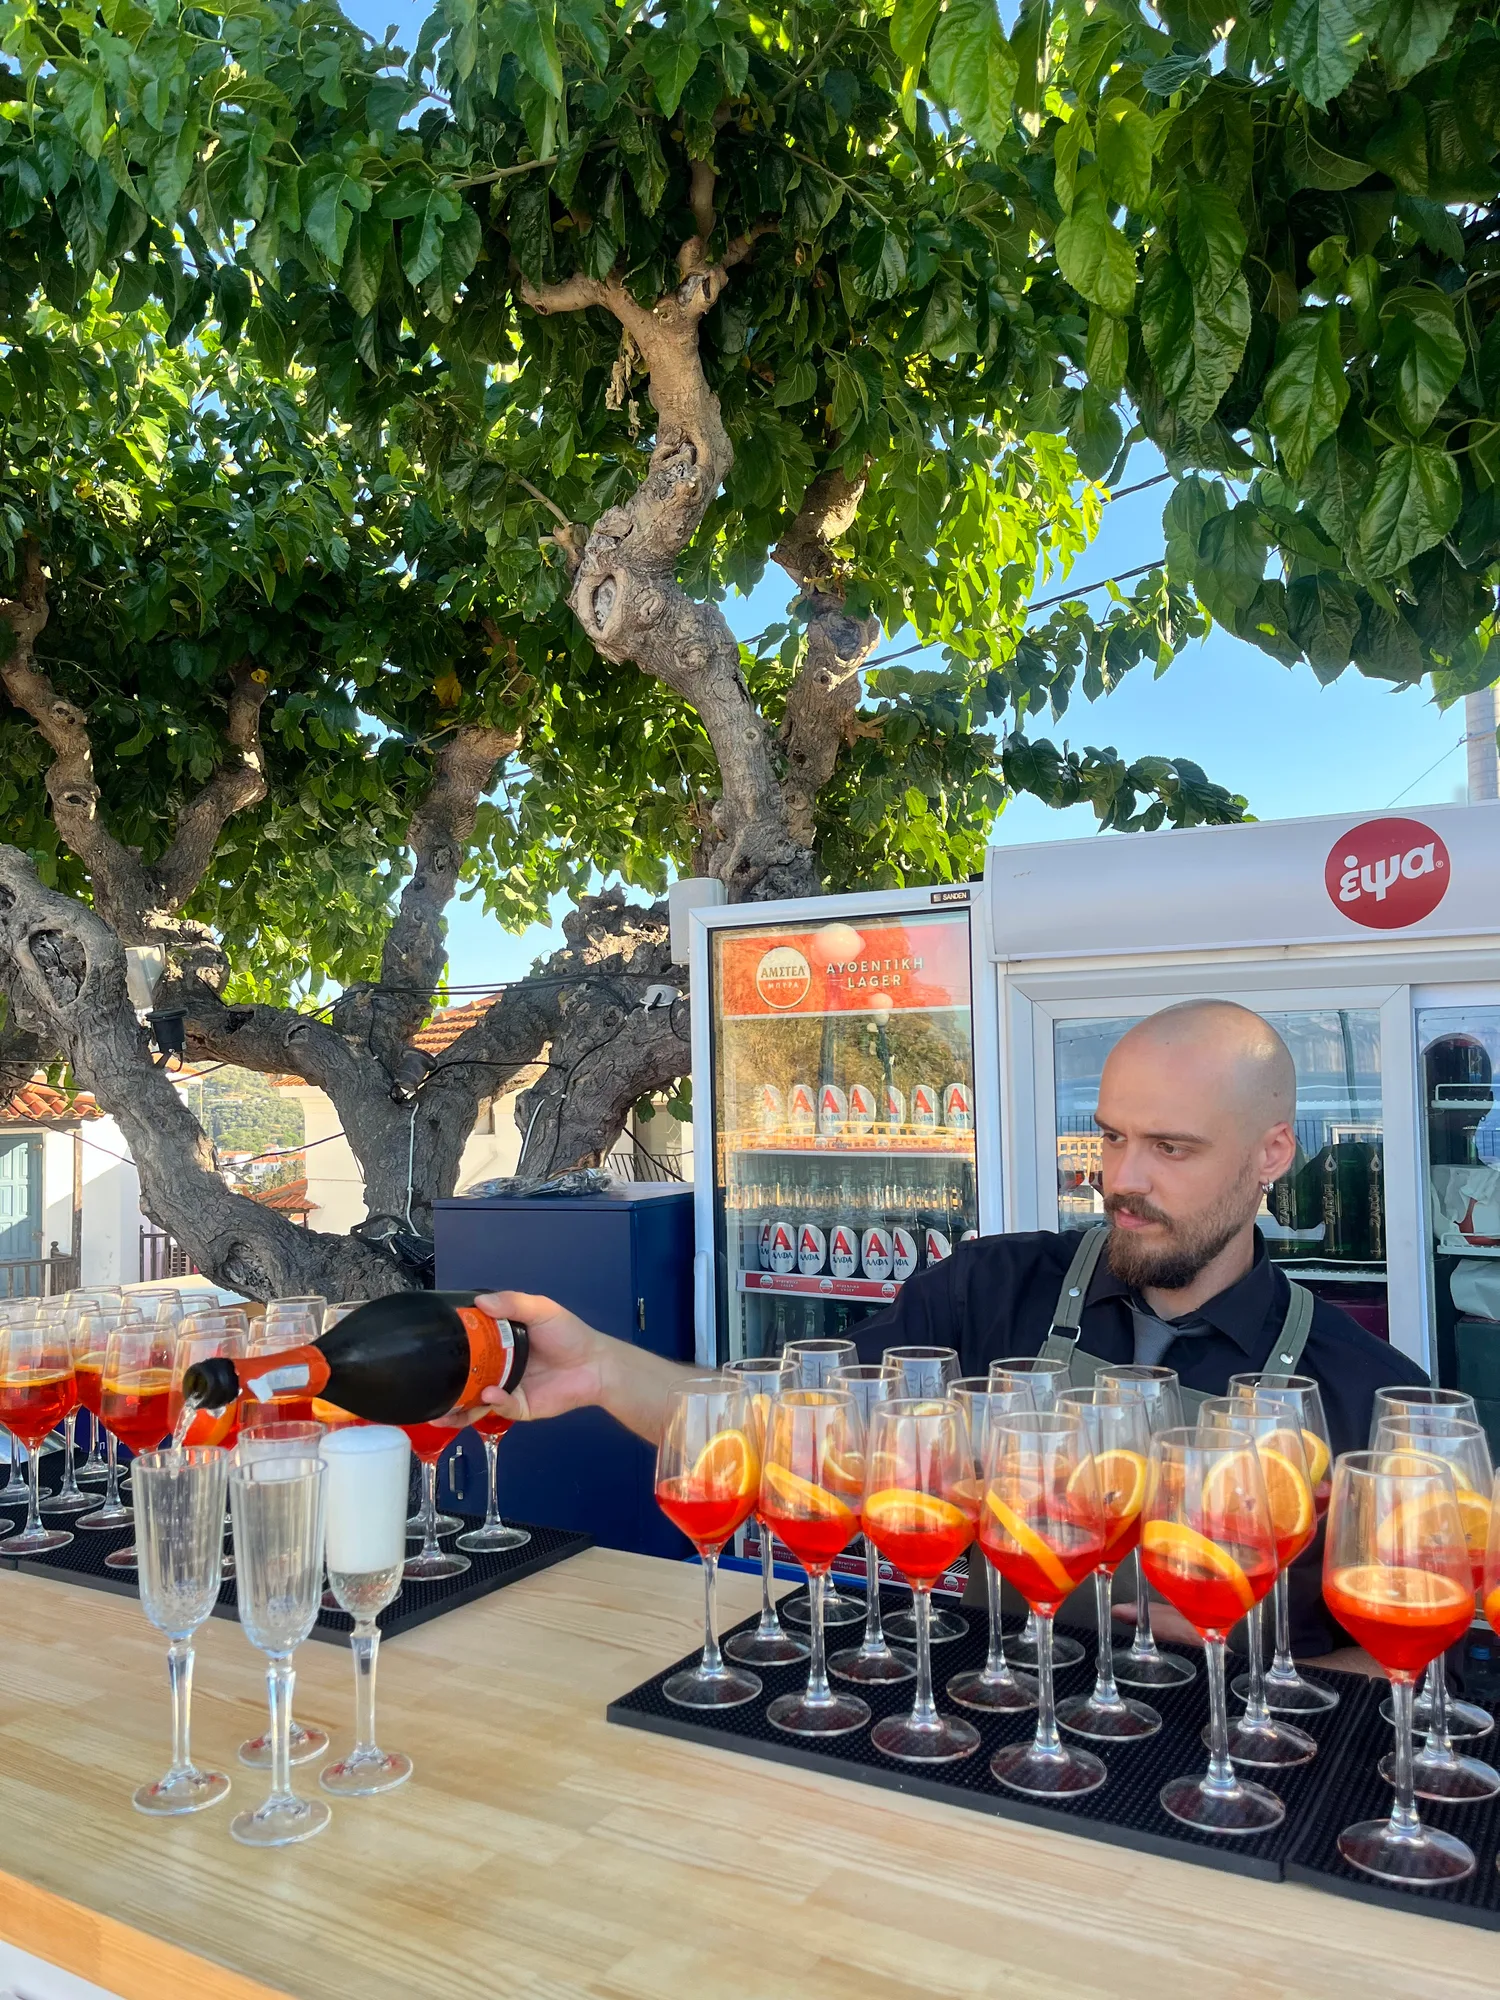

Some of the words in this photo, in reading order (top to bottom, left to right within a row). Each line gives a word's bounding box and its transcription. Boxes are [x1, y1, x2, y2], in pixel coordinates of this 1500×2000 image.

[943, 892, 967, 901] SANDEN
[761, 965, 806, 978] ΑΜΣΤΕΛ
[826, 957, 924, 974] ΑΥΘΕΝΤΙΚΗ
[848, 975, 901, 989] LAGER
